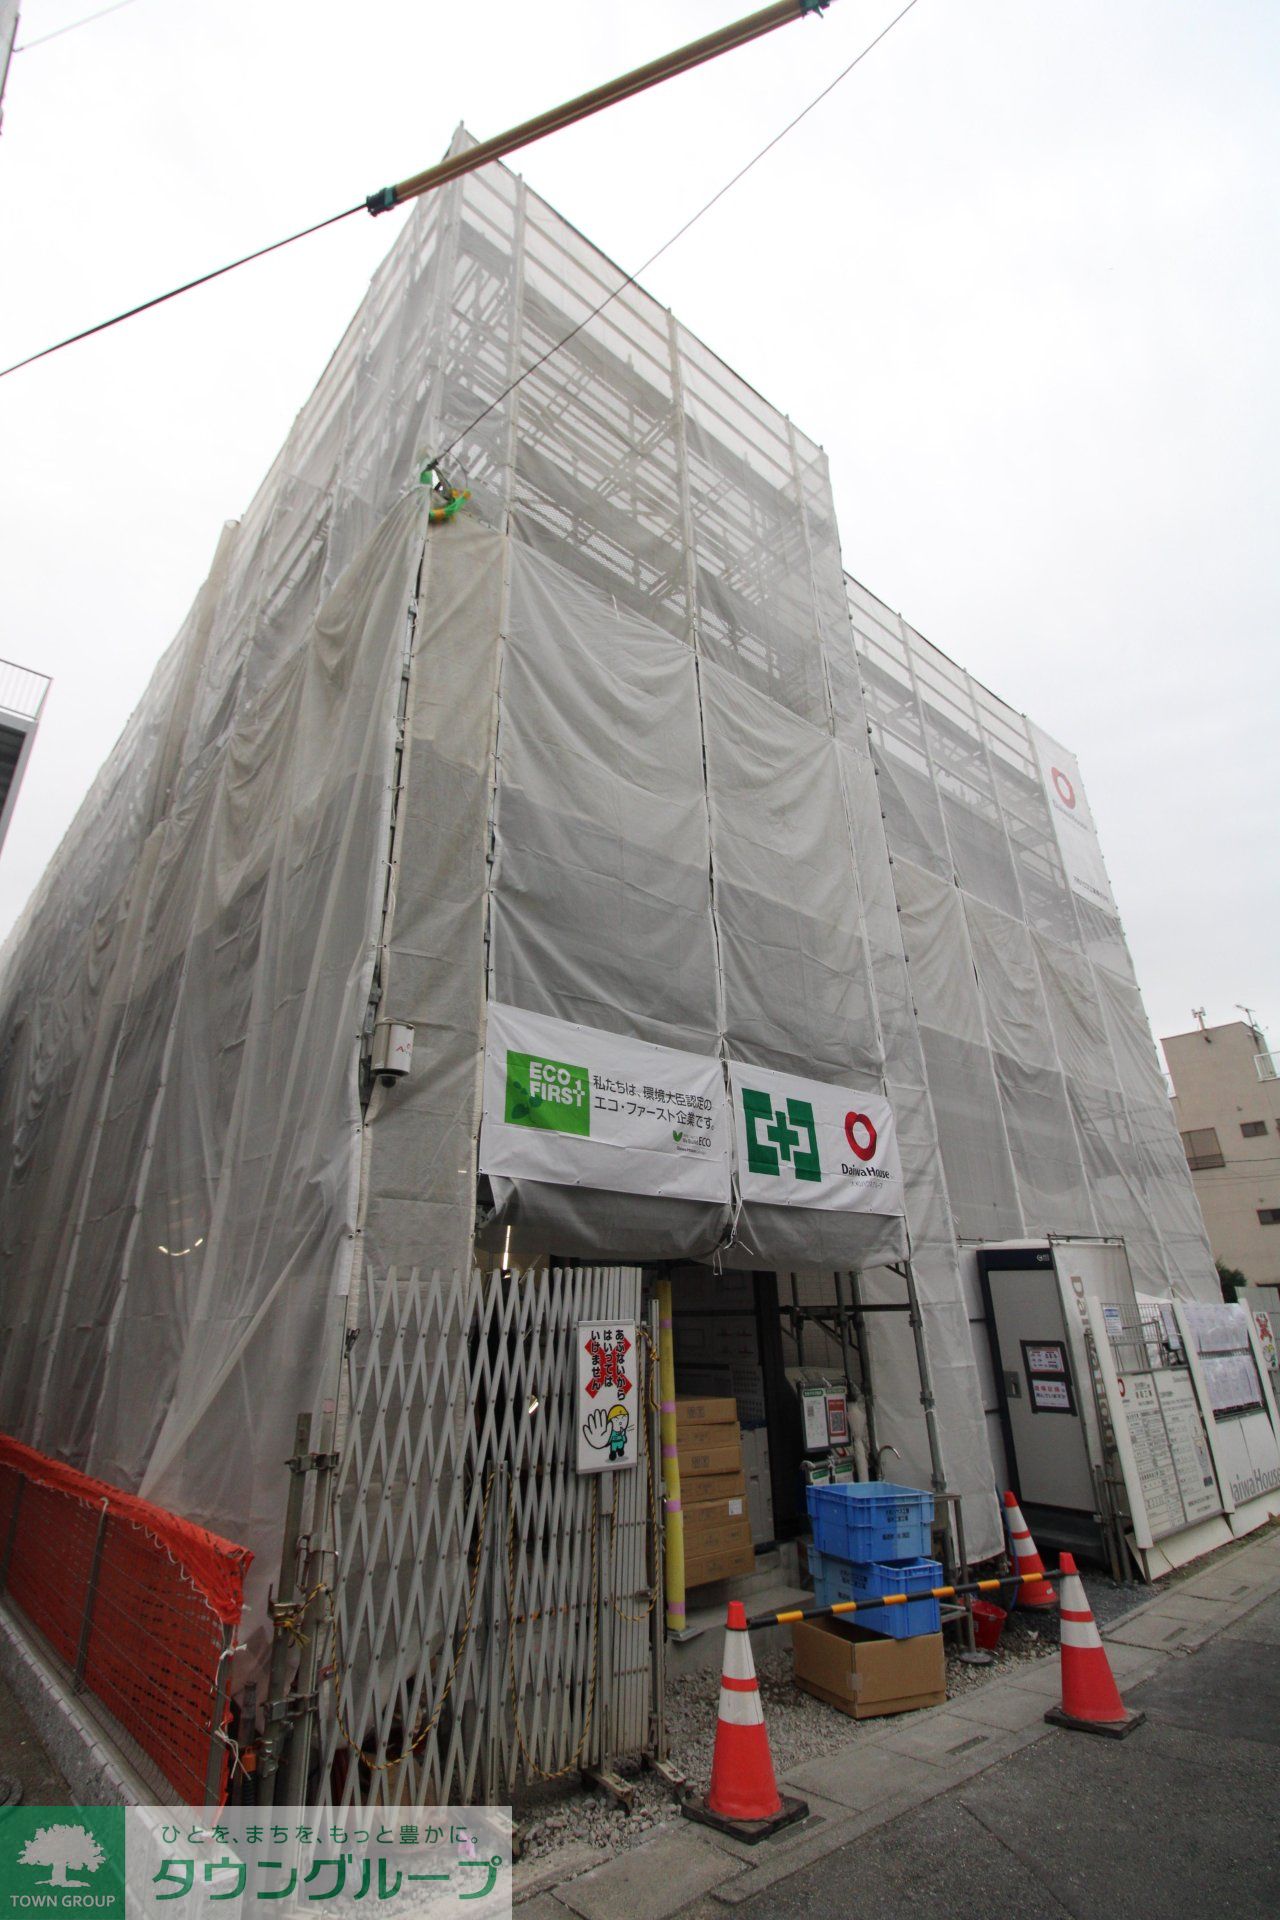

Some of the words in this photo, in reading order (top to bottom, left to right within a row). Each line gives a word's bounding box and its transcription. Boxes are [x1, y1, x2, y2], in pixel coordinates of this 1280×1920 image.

[530, 1061, 571, 1086] ECO
[530, 1079, 585, 1107] FIRST
[593, 1075, 713, 1111] 私たちは、環境大臣認定の
[594, 1096, 715, 1130] エコ・ファースト企業です。
[591, 1330, 601, 1391] いけません
[603, 1329, 613, 1388] はいっては
[615, 1329, 626, 1401] あぶないから
